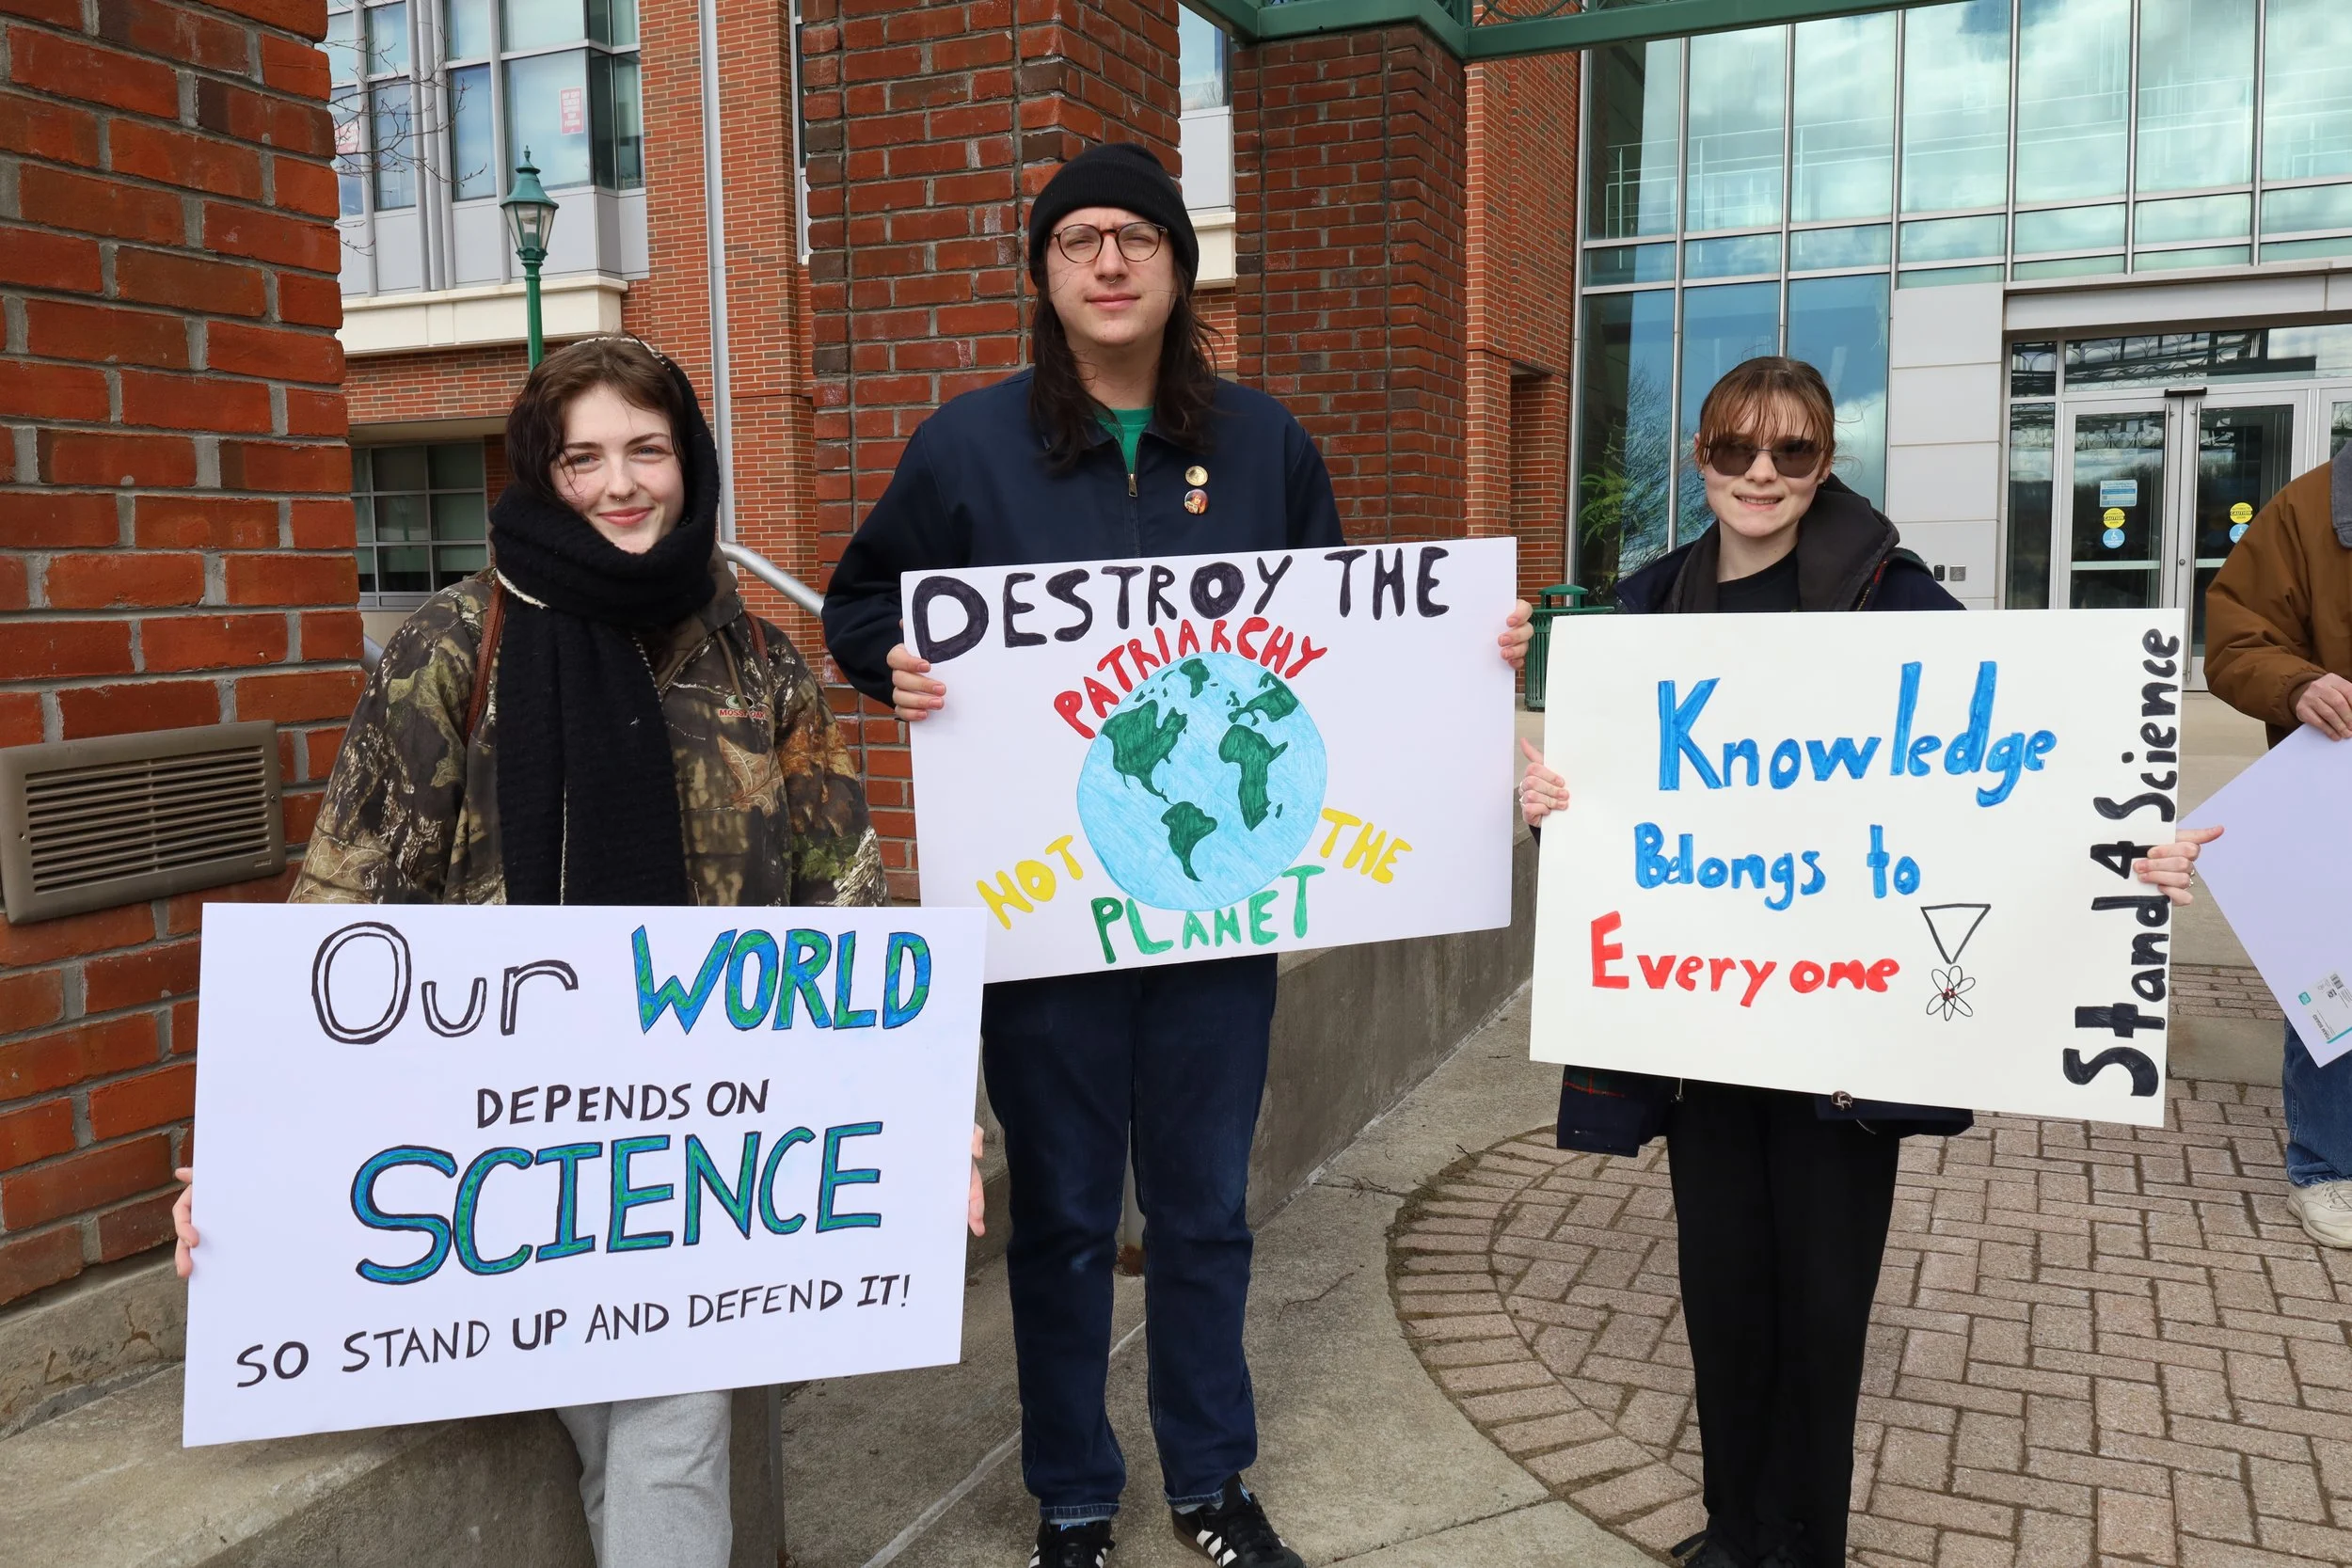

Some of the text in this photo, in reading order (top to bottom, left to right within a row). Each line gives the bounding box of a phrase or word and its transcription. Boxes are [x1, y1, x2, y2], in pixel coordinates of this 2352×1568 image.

[911, 546, 1450, 664] DESTROY THE
[1055, 617, 1327, 738] PATRIARCHY
[1658, 661, 2056, 807] Knowledge
[977, 808, 1413, 929] NOT THE
[1091, 864, 1325, 964] PLANET
[1635, 822, 1920, 909] Belongs to
[2062, 629, 2179, 1098] Stand 4 Science
[311, 922, 931, 1045] Our WORLD
[1591, 910, 1899, 1007] Everyone
[478, 1079, 769, 1128] DEPENDS ON
[350, 1120, 883, 1285] SCIENCE
[237, 1275, 910, 1387] SO STAND UP AND DEFEND IT!
